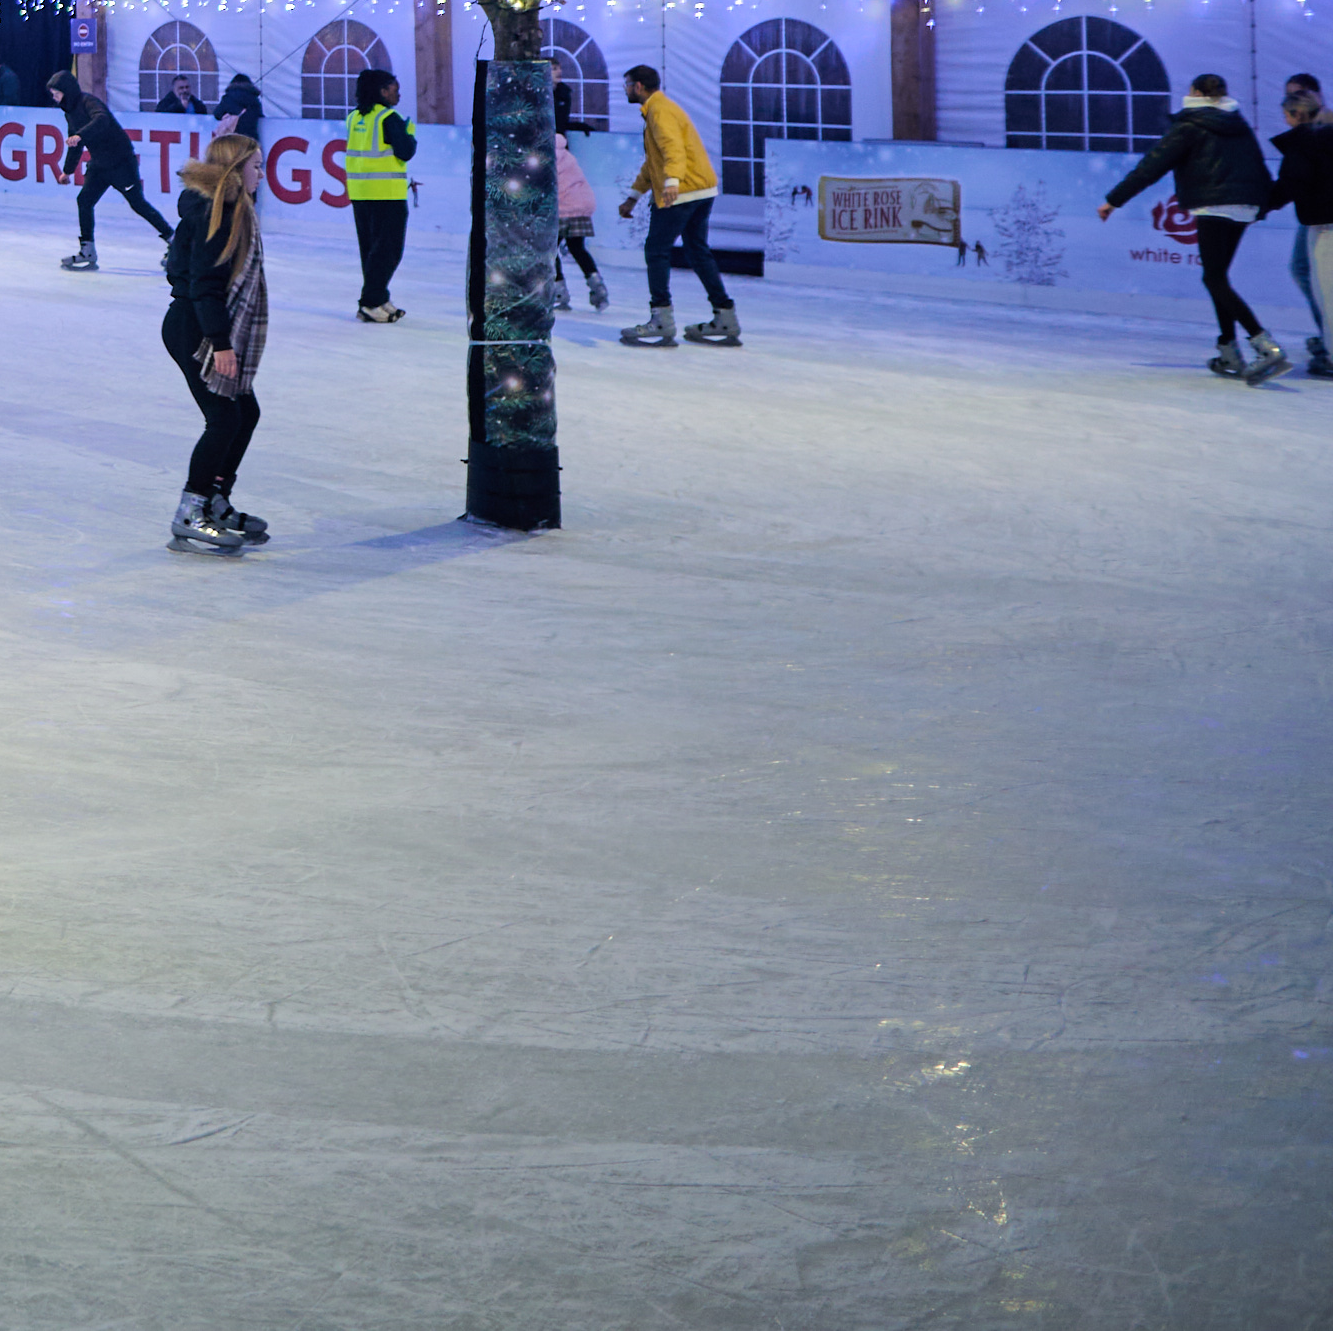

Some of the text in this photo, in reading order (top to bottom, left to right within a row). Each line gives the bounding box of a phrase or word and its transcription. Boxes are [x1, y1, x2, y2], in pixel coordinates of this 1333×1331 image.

[833, 190, 903, 209] WHITE ROSE
[832, 206, 903, 231] ICE RINK
[1130, 247, 1182, 264] white
